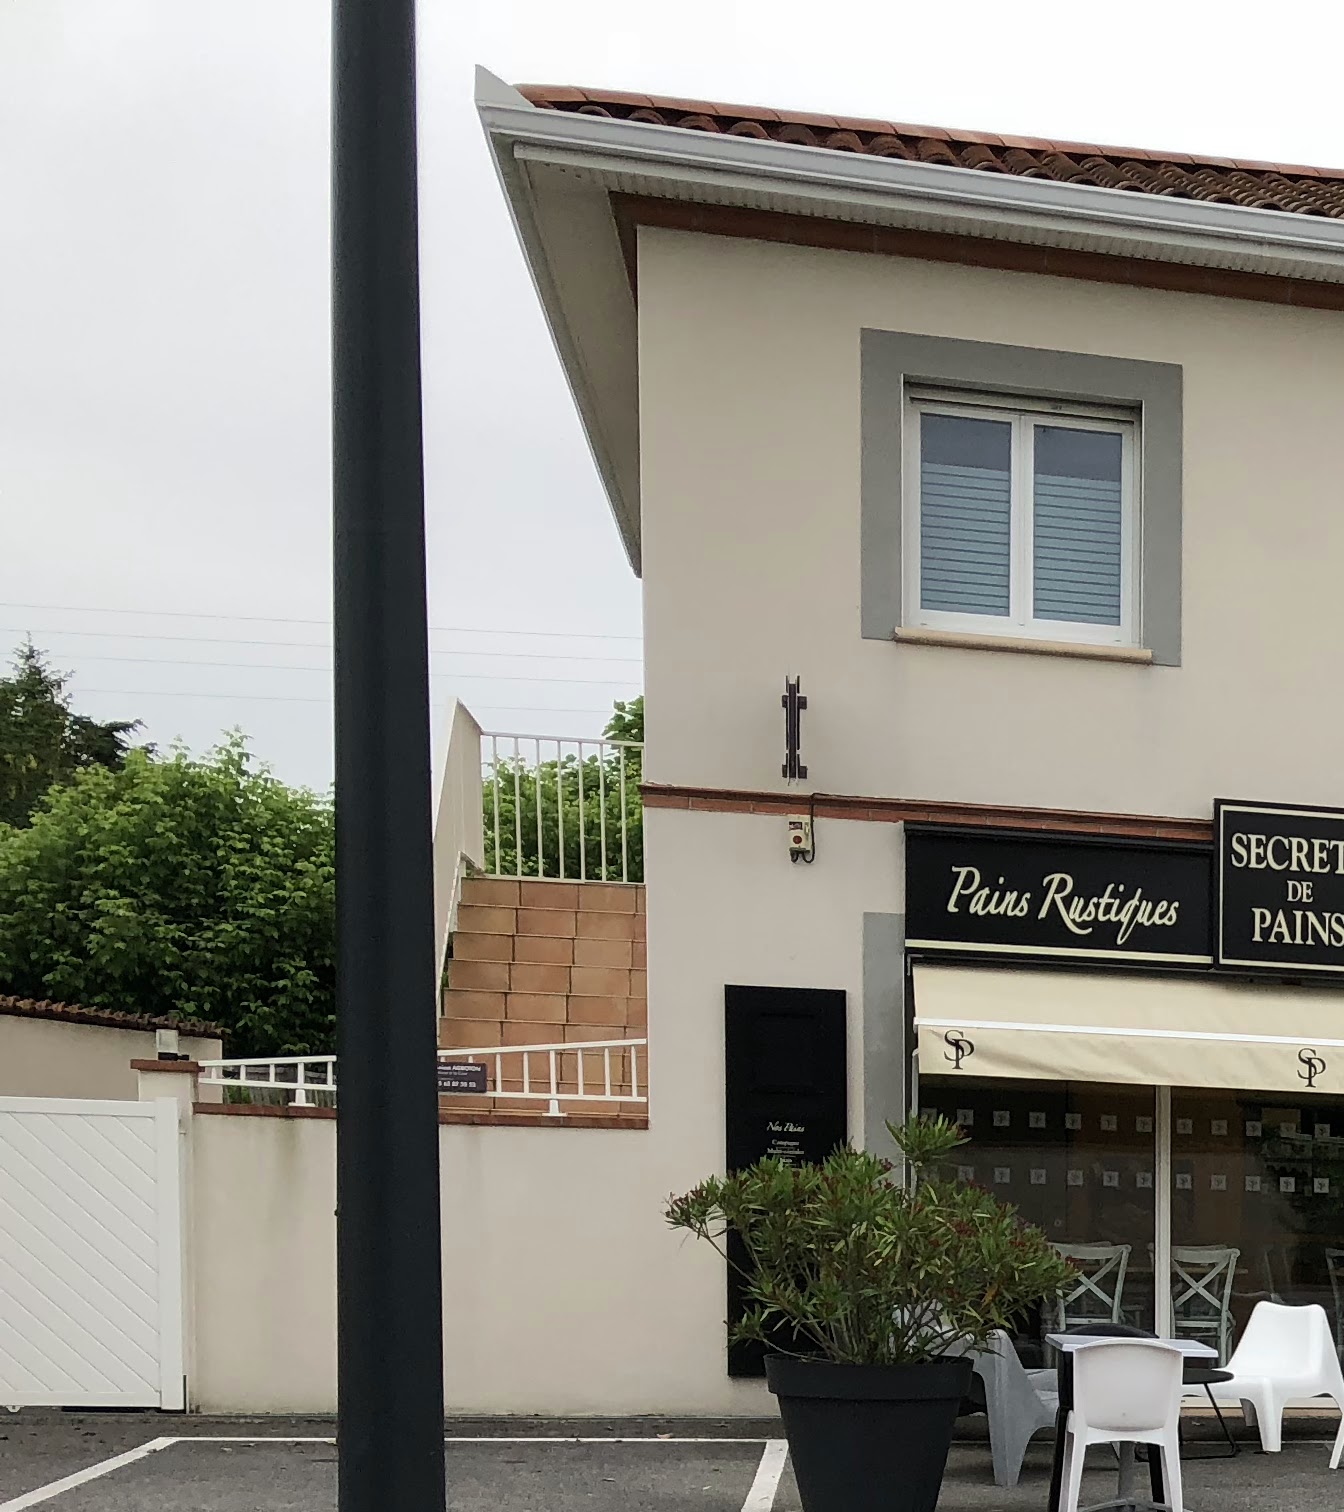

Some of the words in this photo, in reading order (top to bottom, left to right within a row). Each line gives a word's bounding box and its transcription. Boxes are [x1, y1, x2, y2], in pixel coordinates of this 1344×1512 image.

[1286, 880, 1314, 903] DE
[947, 865, 1031, 918] Pains
[1037, 872, 1180, 946] Rustiques
[766, 1120, 782, 1132] Nos
